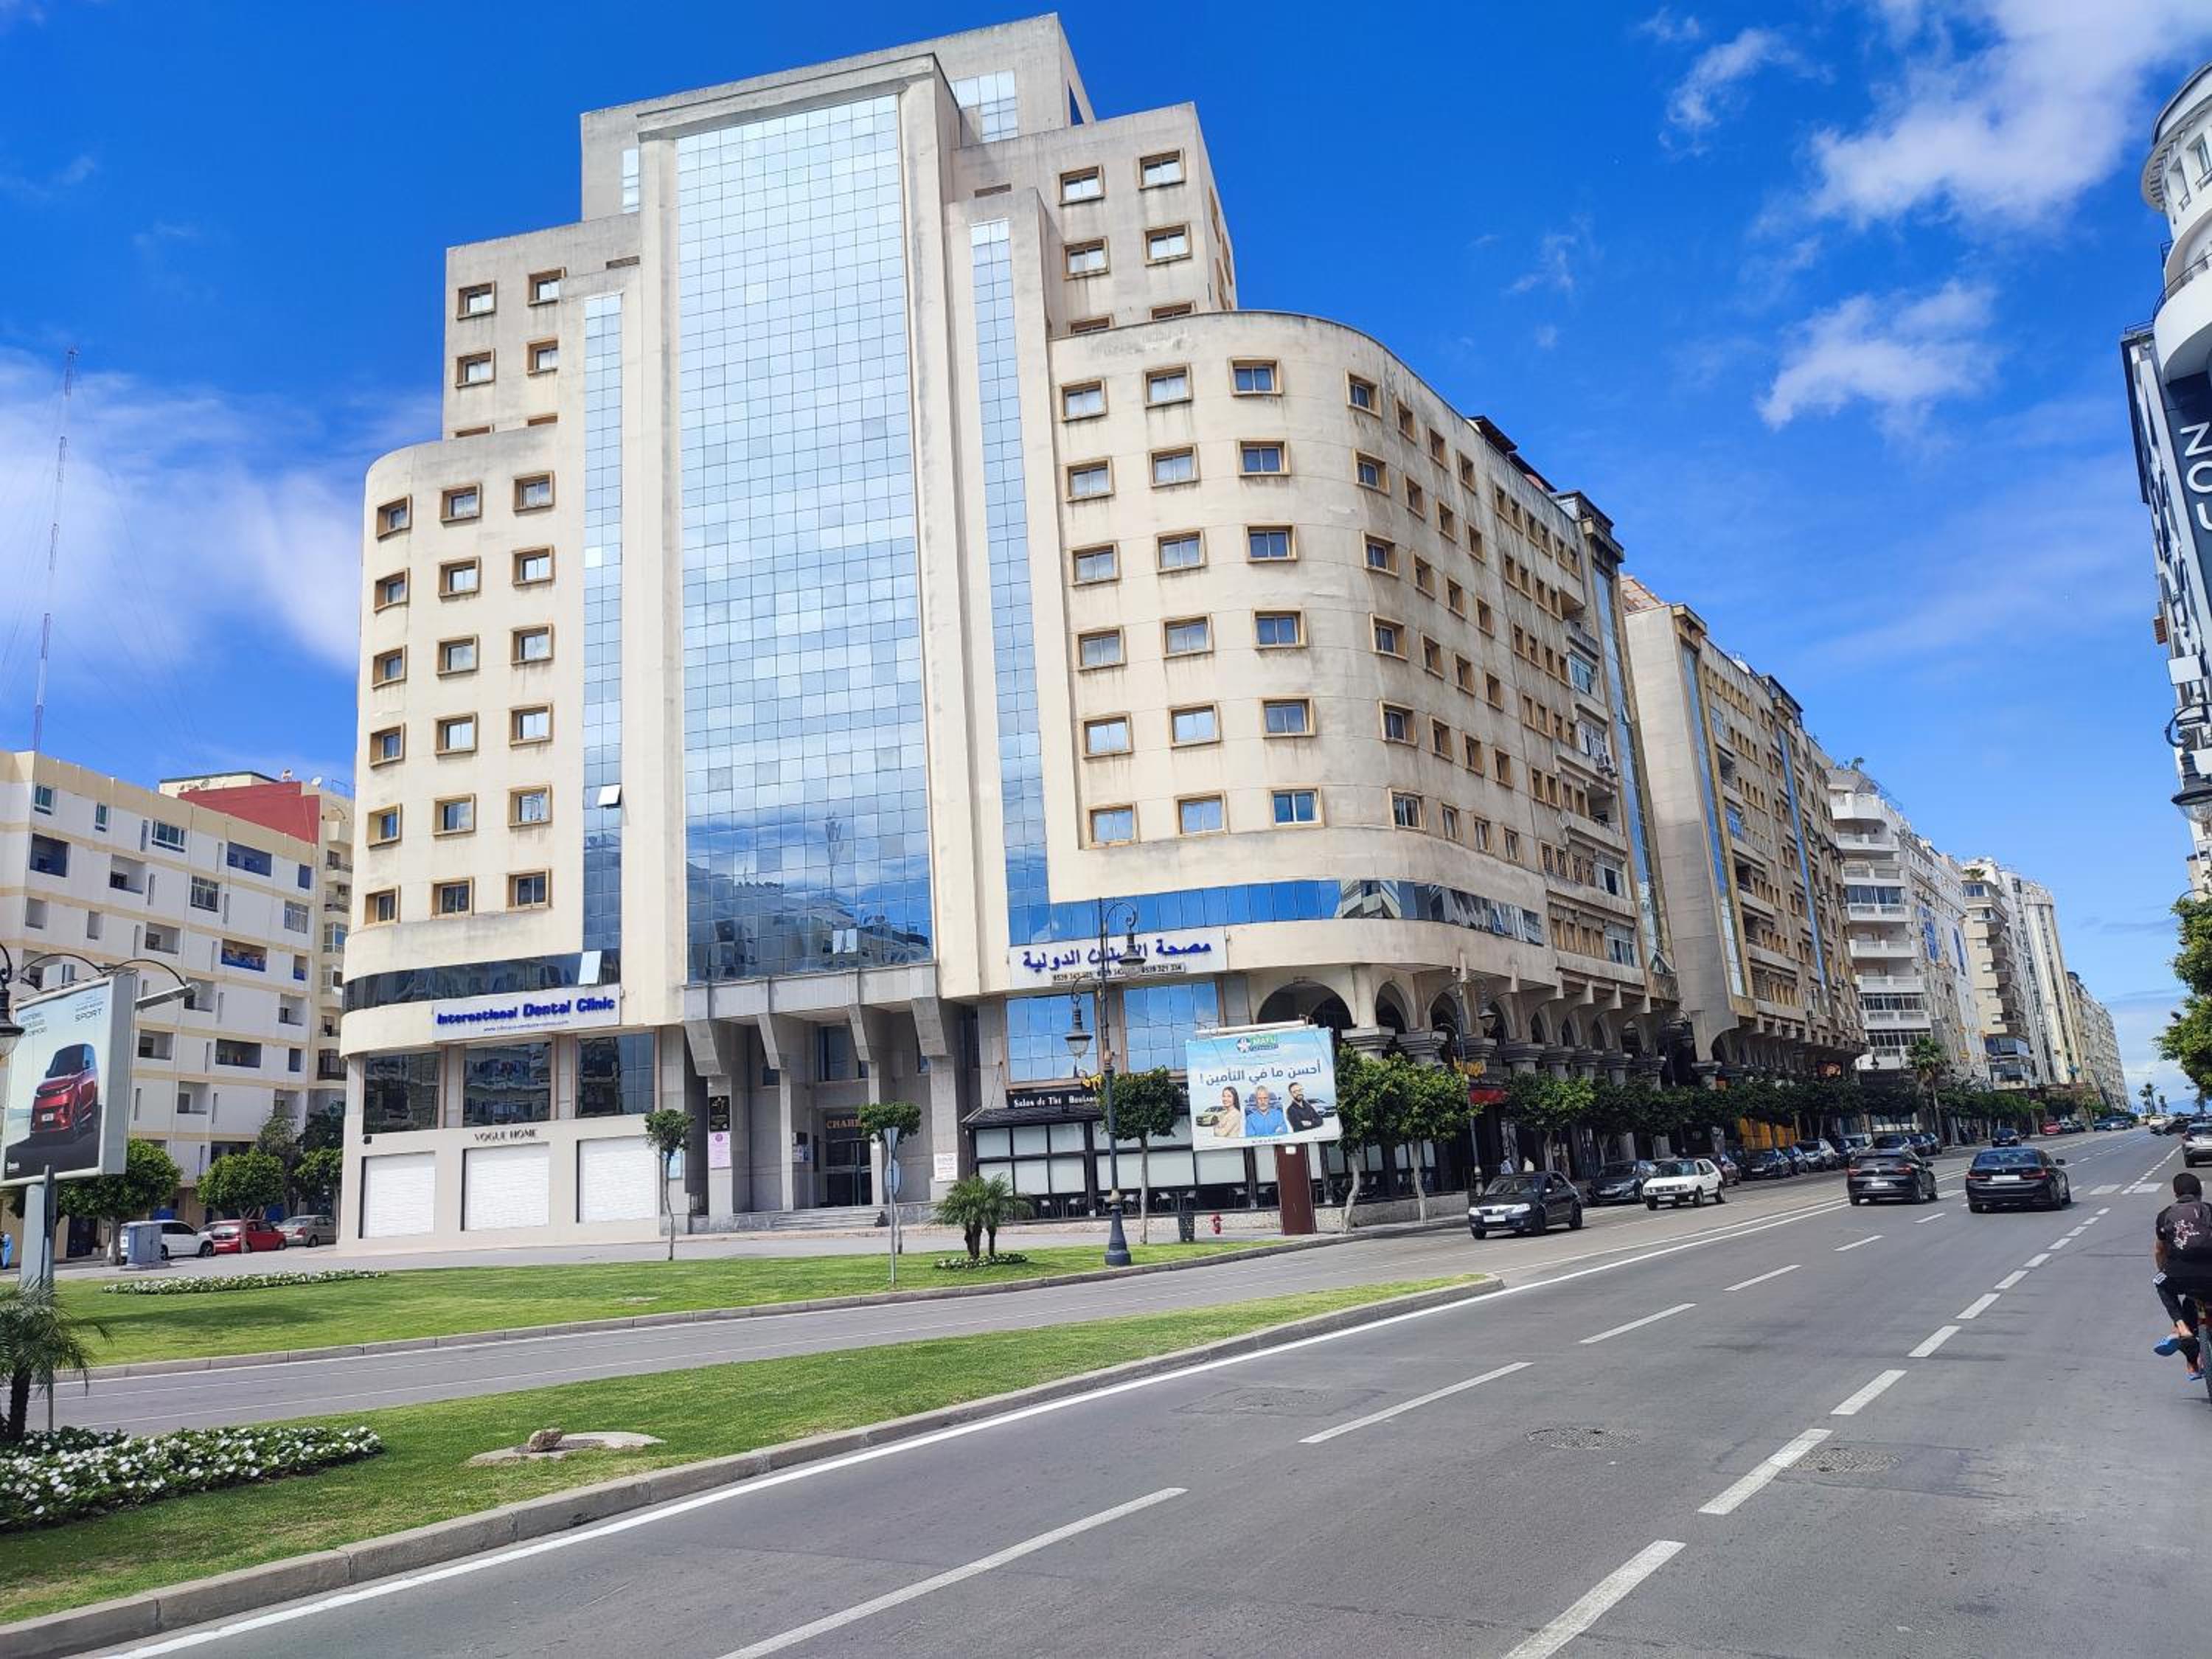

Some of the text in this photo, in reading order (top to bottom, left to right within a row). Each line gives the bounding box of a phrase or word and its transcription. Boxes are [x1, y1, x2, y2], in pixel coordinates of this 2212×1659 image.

[1155, 938, 1211, 956] مصحة
[1023, 950, 1080, 972] الدولية
[74, 1008, 102, 1023] SPORT
[437, 1006, 518, 1026] International
[523, 1000, 571, 1018] Dental
[576, 996, 616, 1013] Clinic
[1206, 1068, 1245, 1086] التأمين
[1248, 1068, 1267, 1084] في
[1271, 1067, 1284, 1077] ما
[1287, 1059, 1321, 1079] أحسن
[1014, 1098, 1034, 1107] Salon
[473, 1128, 538, 1142] VOGUE HOME
